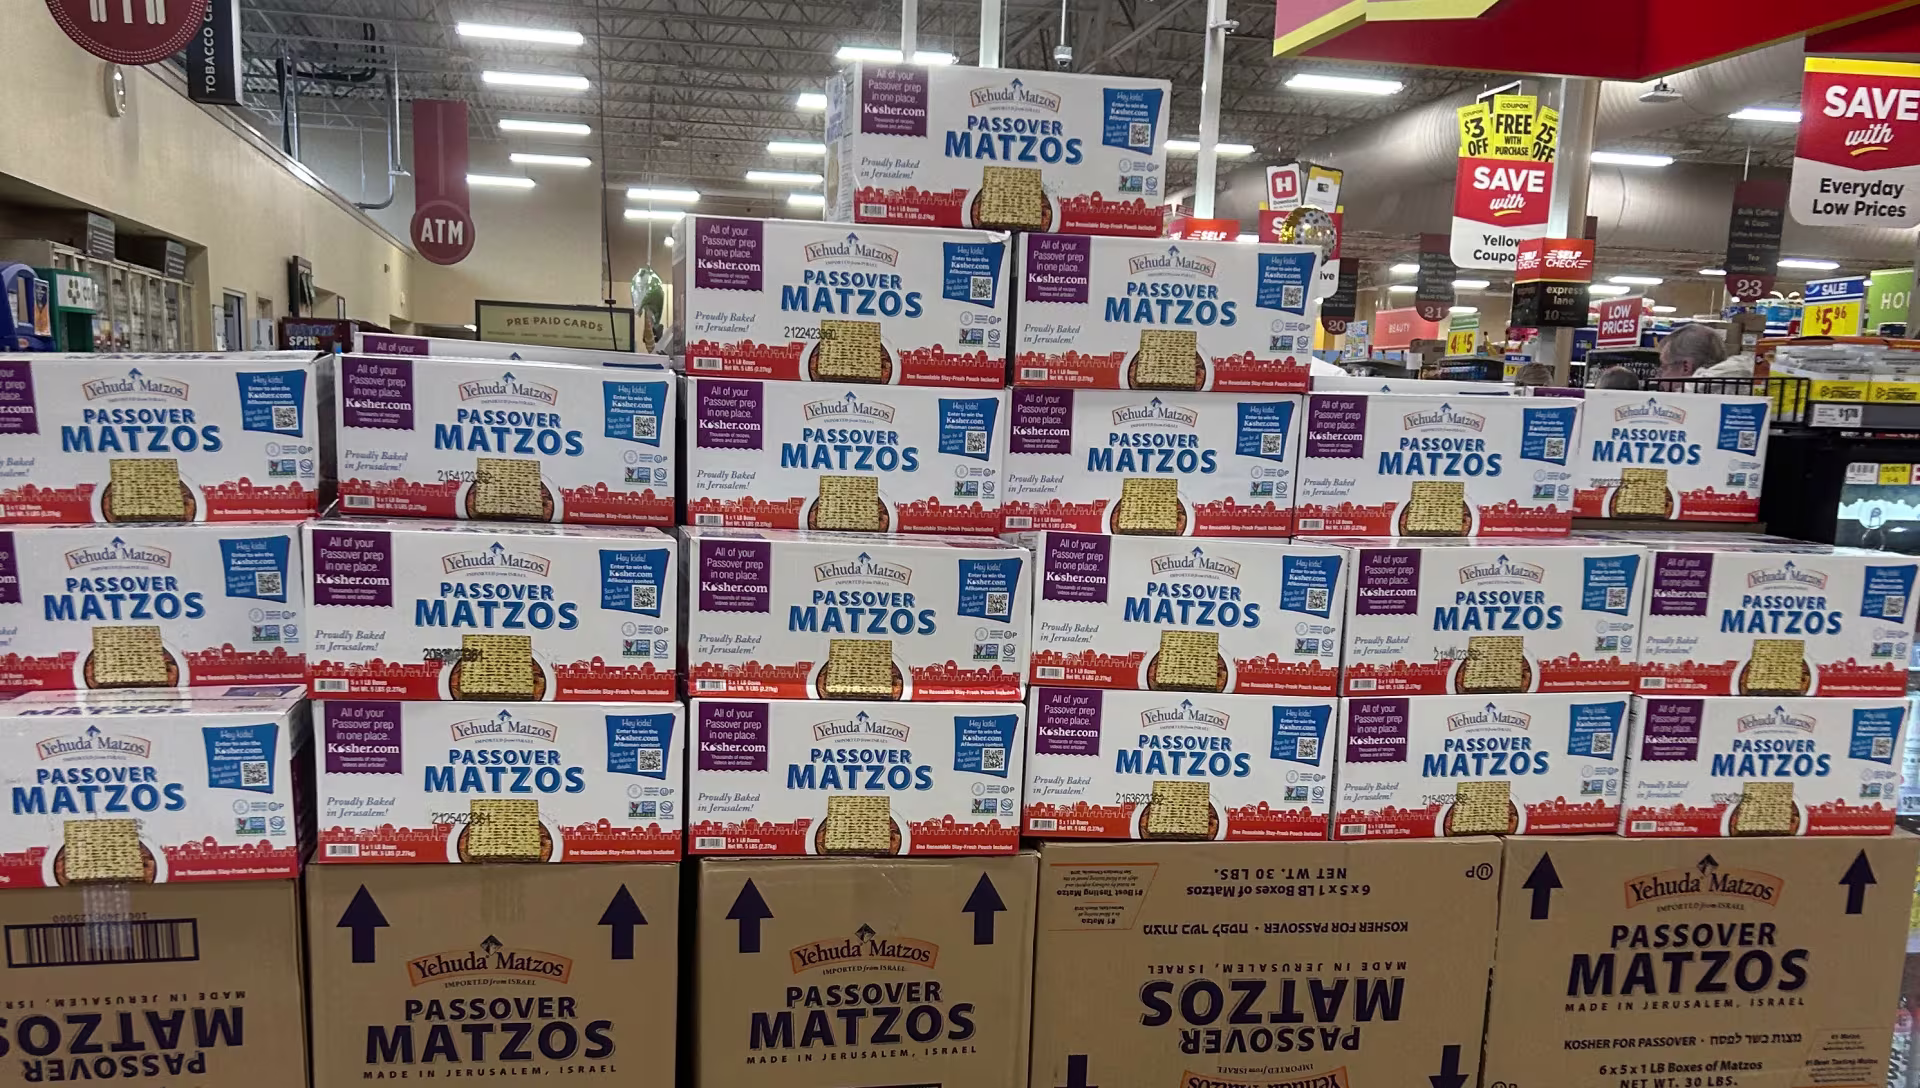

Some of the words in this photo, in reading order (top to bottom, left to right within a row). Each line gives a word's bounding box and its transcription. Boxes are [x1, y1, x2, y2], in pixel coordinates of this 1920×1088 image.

[204, 0, 213, 22] CE
[203, 27, 216, 93] TOBACCO
[1823, 85, 1920, 121] SAVE
[967, 115, 1064, 137] PASSOVER
[1464, 117, 1485, 138] $3
[1495, 113, 1533, 135] FREE
[1504, 136, 1522, 145] WITH
[1845, 123, 1894, 146] with
[944, 130, 1083, 165] MATZOS
[1468, 138, 1489, 157] OFF
[1495, 146, 1529, 156] PURCHASE
[1533, 142, 1555, 162] OFF
[1276, 176, 1293, 193] H
[1473, 166, 1545, 193] SAVE
[1820, 178, 1905, 199] Everyday
[1489, 194, 1527, 210] with
[1812, 199, 1849, 215] Low
[1854, 201, 1906, 218] Prices
[420, 217, 463, 245] ATM
[709, 224, 720, 234] All
[721, 225, 730, 235] of
[731, 227, 749, 237] your
[1201, 231, 1227, 241] SELF
[701, 234, 737, 246] Passover
[738, 239, 756, 249] prep
[706, 247, 713, 256] in
[714, 248, 729, 257] one
[729, 248, 753, 260] place.
[1473, 249, 1516, 263] Coupo
[1546, 258, 1579, 269] CHECK
[803, 269, 902, 290] PASSOVER
[1320, 271, 1335, 280] ive
[1126, 282, 1219, 300] PASSOVER
[1546, 286, 1584, 296] express
[1736, 279, 1762, 297] 23
[1821, 284, 1848, 296] SALE!
[780, 284, 923, 319] MATZOS
[1553, 295, 1575, 306] lane
[1104, 296, 1238, 327] MATZOS
[1424, 307, 1442, 318] 21
[1544, 310, 1559, 320] 10
[1608, 304, 1631, 320] LOW
[563, 318, 603, 331] CARDS
[1328, 320, 1346, 332] 20
[1602, 320, 1635, 334] PRICES
[82, 407, 197, 426] PASSOVER
[456, 408, 562, 429] PASSOVER
[59, 423, 224, 454] MATZOS
[433, 423, 585, 457] MATZOS
[802, 428, 899, 446] PASSOVER
[1108, 433, 1200, 449] PASSOVER
[1611, 427, 1688, 443] PASSOVER
[1399, 437, 1486, 453] PASSOVER
[1591, 440, 1702, 466] MATZOS
[780, 442, 919, 473] MATZOS
[1087, 447, 1218, 474] MATZOS
[1378, 451, 1503, 477] MATZOS
[65, 575, 180, 595] PASSOVER
[440, 582, 555, 601] PASSOVER
[1146, 582, 1242, 602] PASSOVER
[41, 590, 207, 623] MATZOS
[812, 590, 915, 608] PASSOVER
[1455, 589, 1546, 607] PASSOVER
[1742, 595, 1827, 611] PASSOVER
[414, 599, 579, 630] MATZOS
[788, 605, 936, 635] MATZOS
[1123, 596, 1261, 629] MATZOS
[1433, 603, 1564, 633] MATZOS
[1720, 609, 1844, 635] MATZOS
[817, 721, 860, 738] Yehuda
[865, 722, 905, 738] Matzos
[1138, 734, 1232, 752] PASSOVER
[1443, 736, 1533, 754] PASSOVER
[1732, 738, 1817, 754] PASSOVER
[448, 749, 562, 766] PASSOVER
[810, 748, 913, 765] PASSOVER
[1115, 749, 1251, 778] MATZOS
[1421, 749, 1550, 779] MATZOS
[1710, 752, 1832, 778] MATZOS
[35, 765, 159, 787] PASSOVER
[423, 765, 586, 794] MATZOS
[787, 764, 934, 791] MATZOS
[9, 781, 188, 817] MATZOS
[326, 796, 365, 809] Proudly
[366, 796, 396, 806] Baked
[326, 808, 337, 817] in
[337, 808, 390, 819] Jerusalem!
[1214, 868, 1250, 881] LBS.
[1256, 868, 1275, 880] 30
[1280, 868, 1310, 880] WT.
[1316, 867, 1347, 880] NET
[1186, 885, 1235, 897] Matzos
[1238, 885, 1253, 897] of
[1255, 885, 1295, 896] Boxes
[1629, 872, 1701, 902] Yehuda
[1709, 872, 1775, 901] Matzos
[1143, 924, 1179, 935] מצות
[1181, 924, 1208, 935] כשר
[1212, 923, 1249, 937] לפסח
[1263, 922, 1328, 934] PASSOVER
[1331, 922, 1357, 933] FOR
[1359, 921, 1409, 933] KOSHER
[1610, 922, 1777, 949] PASSOVER
[413, 951, 488, 979] Yehuda
[496, 951, 564, 977] Matzos
[1567, 948, 1810, 997] MATZOS
[46, 994, 159, 1008] JERUSALEM,
[170, 992, 187, 1001] IN
[199, 990, 246, 1001] MADE
[786, 981, 943, 1007] PASSOVER
[1139, 977, 1406, 1027] MATZOS
[405, 996, 577, 1022] PASSOVER
[0, 1007, 244, 1058] MATZO
[750, 1003, 977, 1050] MATZOS
[366, 1020, 616, 1064] MATZOS
[1178, 1026, 1360, 1054] PASSOVER
[1564, 1039, 1610, 1050] KOSHER
[1612, 1038, 1636, 1049] FOR
[1638, 1036, 1697, 1048] PASSOVER
[23, 1051, 207, 1083] PASSOVER
[363, 1070, 413, 1080] MADE
[420, 1070, 435, 1078] IN
[446, 1066, 550, 1078] JERUSALEM,
[560, 1065, 616, 1074] ISRAEL
